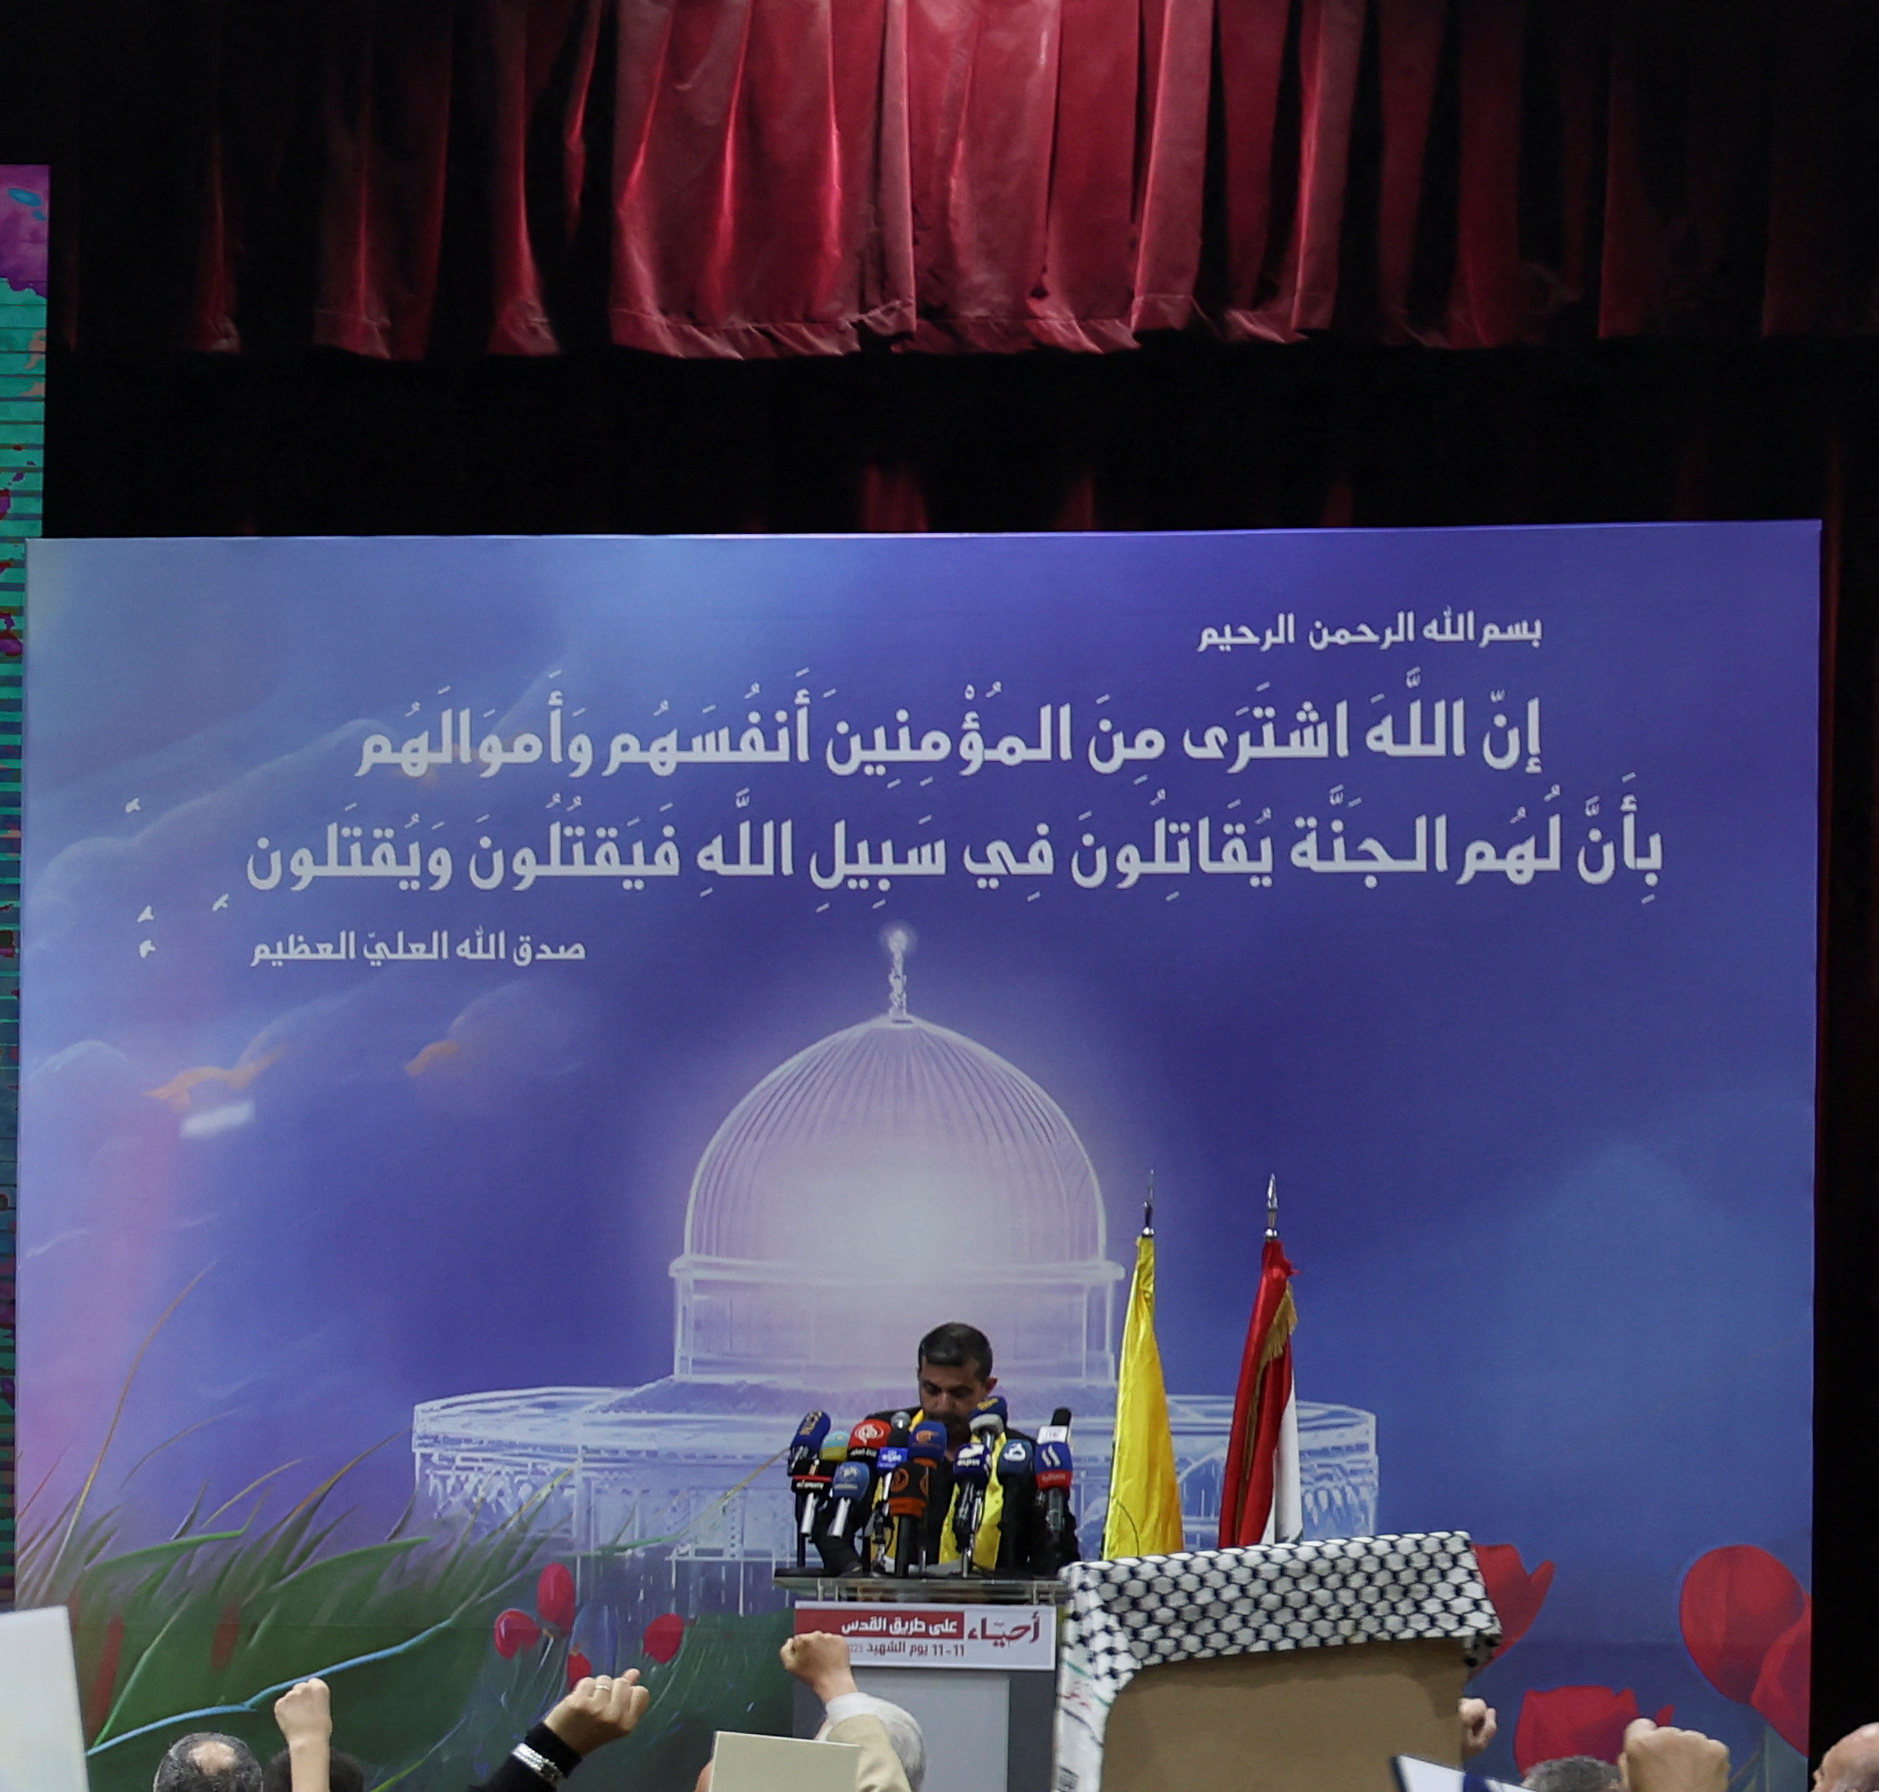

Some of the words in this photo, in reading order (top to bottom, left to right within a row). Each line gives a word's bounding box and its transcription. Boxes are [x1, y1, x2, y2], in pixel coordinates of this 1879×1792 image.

[1196, 612, 1295, 652] الرحيم
[1309, 610, 1415, 651] الرحمن
[1423, 605, 1475, 642] الله
[1479, 618, 1543, 649] بسم
[250, 930, 356, 967] العظيم
[456, 924, 506, 961] الله
[512, 935, 587, 967] صدق
[841, 1616, 887, 1635] القدس
[889, 1617, 926, 1636] طريق
[929, 1618, 957, 1636] على
[867, 1641, 905, 1656] الشهيد
[909, 1644, 928, 1657] يوم
[932, 1643, 964, 1657] 11-11
